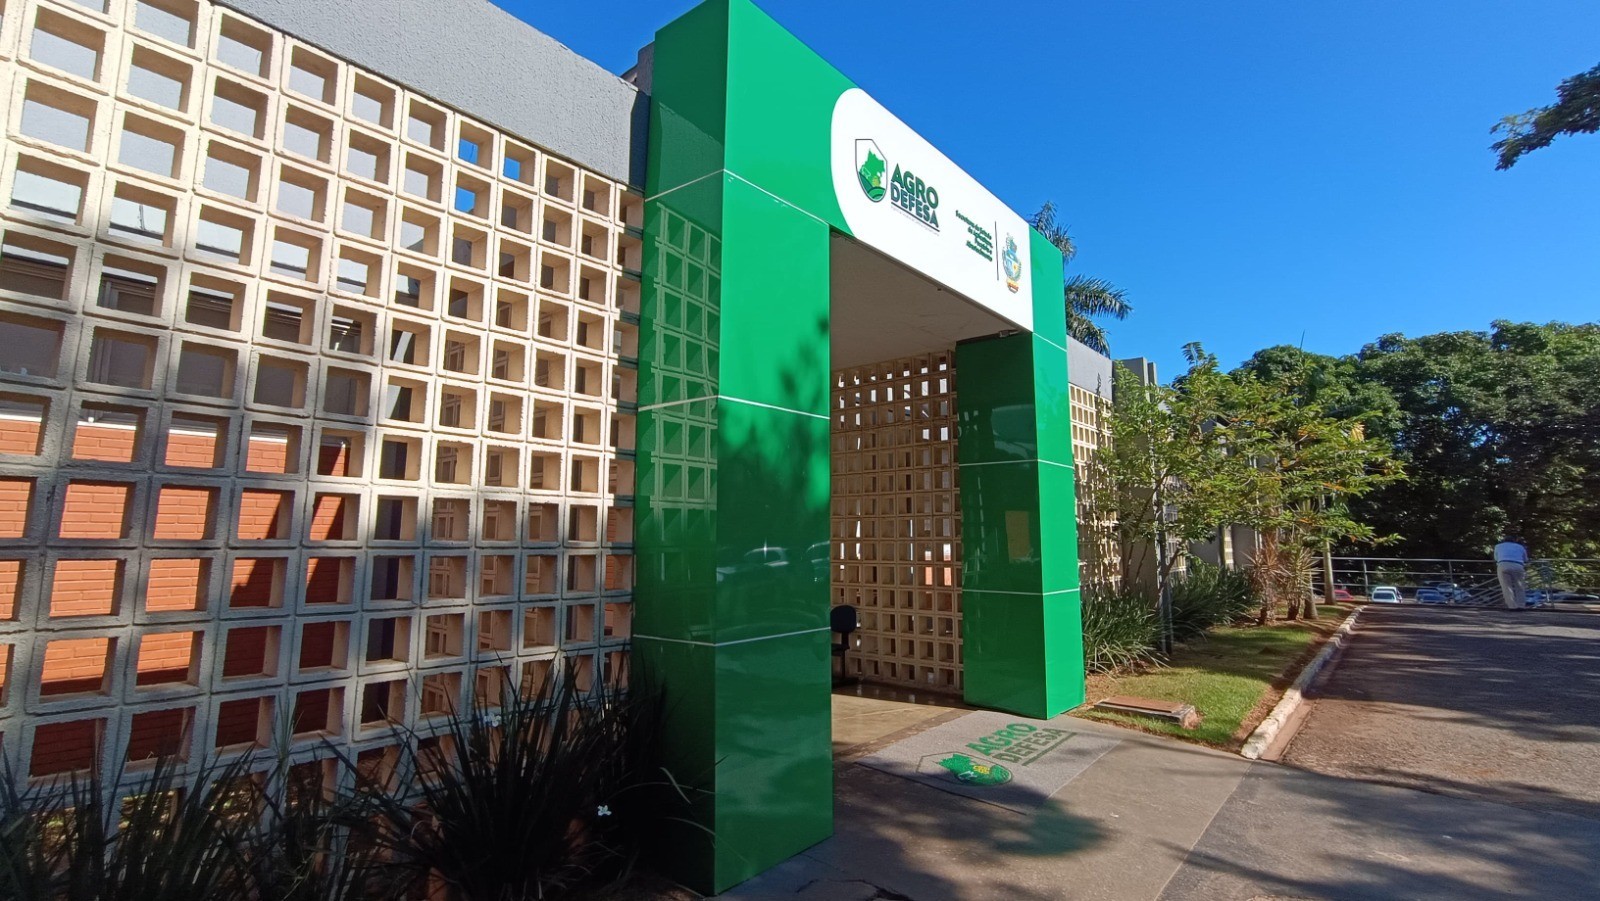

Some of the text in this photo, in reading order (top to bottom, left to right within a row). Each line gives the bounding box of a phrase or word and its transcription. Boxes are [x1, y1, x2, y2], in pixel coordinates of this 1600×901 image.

[890, 182, 939, 228] DEFESA
[891, 163, 939, 209] AGRO
[966, 723, 1037, 756] AGRO
[992, 728, 1069, 763] DEFESA
